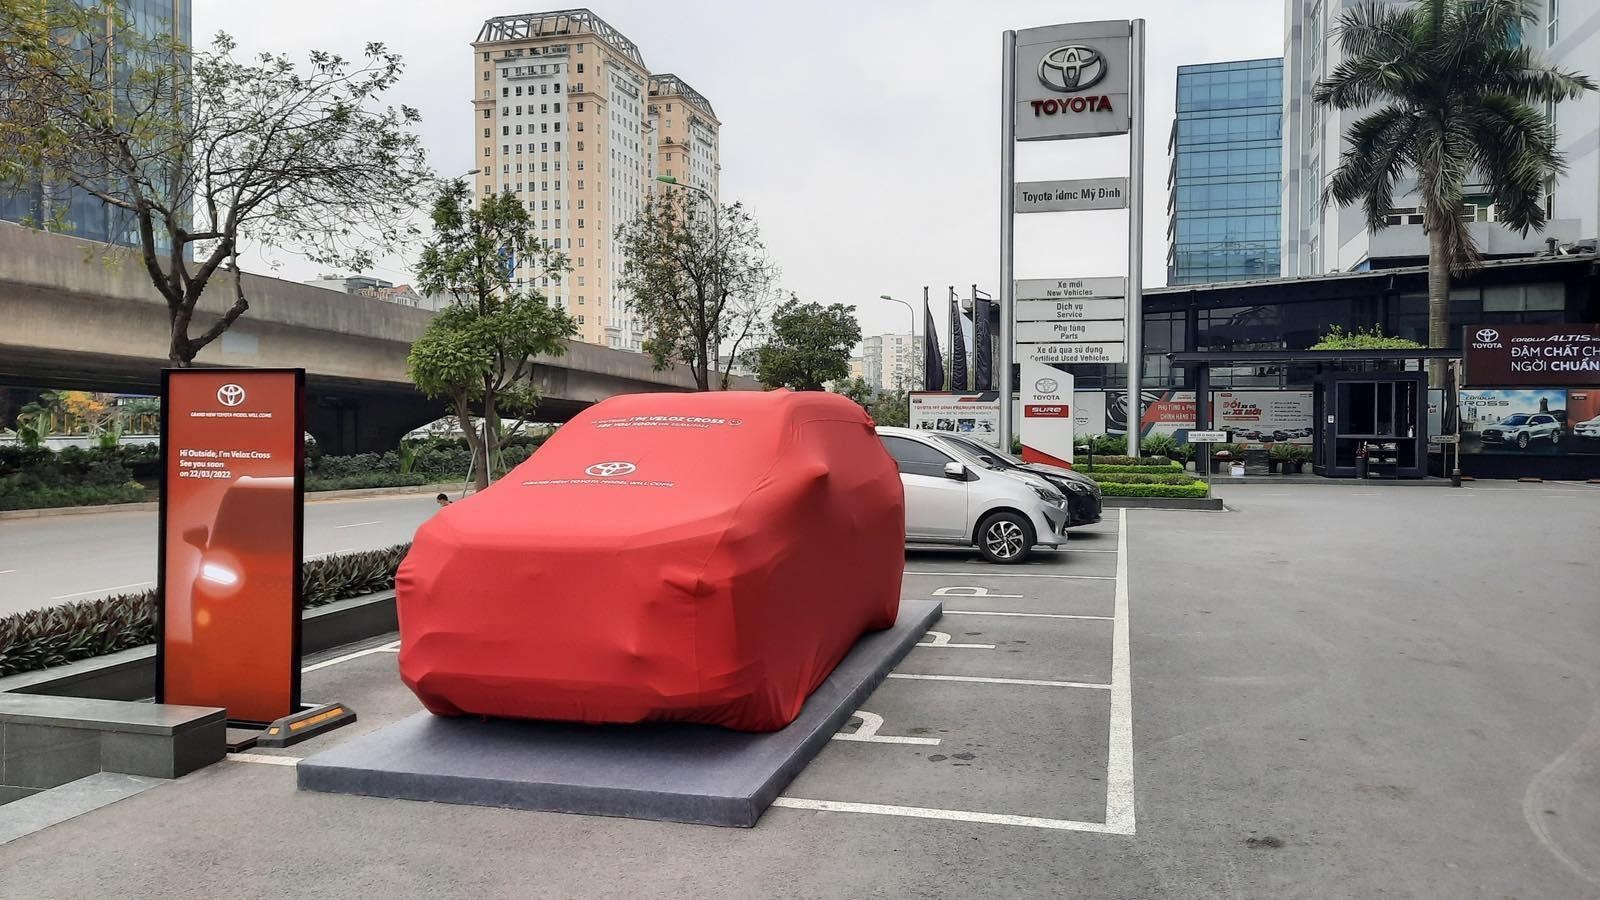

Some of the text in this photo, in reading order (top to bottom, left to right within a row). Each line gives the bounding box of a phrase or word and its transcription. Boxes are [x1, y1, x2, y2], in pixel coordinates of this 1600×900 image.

[1031, 95, 1112, 117] TOYOTA
[1023, 191, 1052, 203] Toyota
[1081, 188, 1096, 201] Mỹ
[1098, 187, 1120, 198] Đình
[1069, 280, 1083, 288] mới
[1056, 303, 1073, 311] Dịch
[1053, 324, 1086, 334] Phụ tùng
[1037, 346, 1047, 354] Xe
[1048, 346, 1057, 354] đã
[1085, 345, 1104, 354] dụng
[1511, 343, 1600, 359] ĐẬM CHẤT CH
[1511, 357, 1600, 371] NGỜI CHUẨN
[686, 417, 725, 425] CROSS
[180, 449, 271, 459] Hi Outside, I'm Veloz Cross
[190, 470, 231, 479] 22/03/2022
